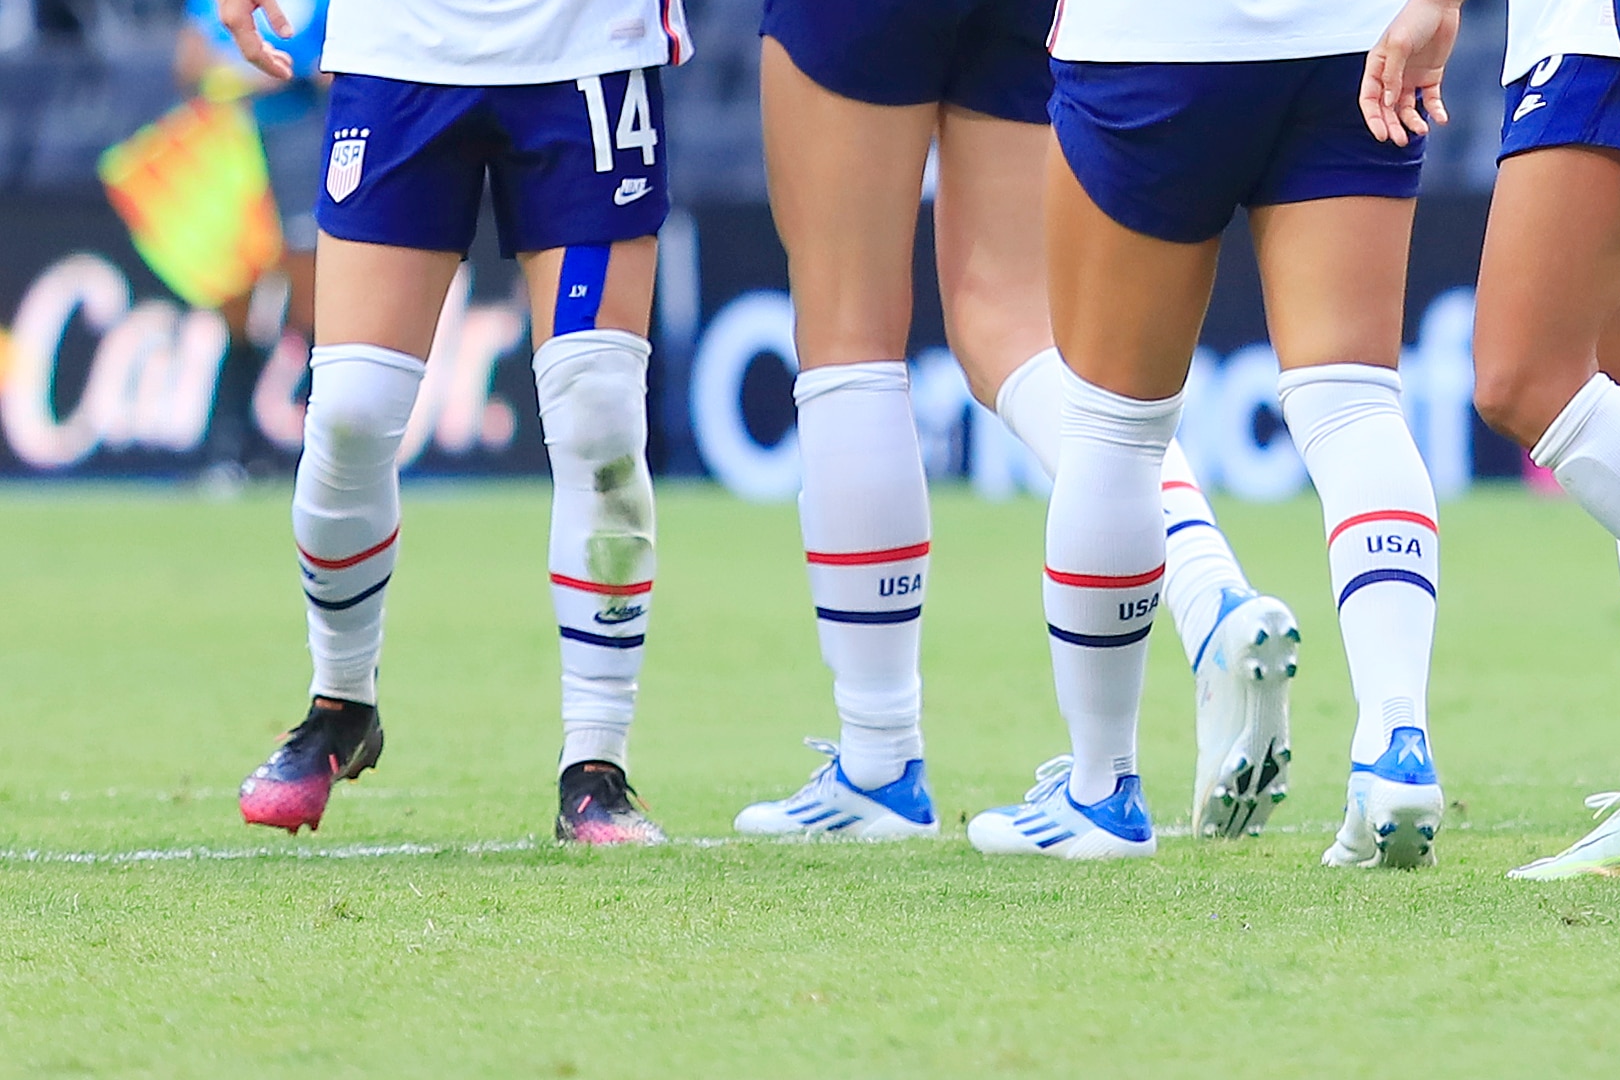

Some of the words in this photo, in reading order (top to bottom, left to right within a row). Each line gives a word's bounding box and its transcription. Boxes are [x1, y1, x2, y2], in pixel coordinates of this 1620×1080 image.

[577, 69, 659, 173] 14
[333, 145, 361, 167] USA
[1366, 534, 1422, 559] USA
[879, 573, 922, 598] USA
[1118, 591, 1160, 621] USA
